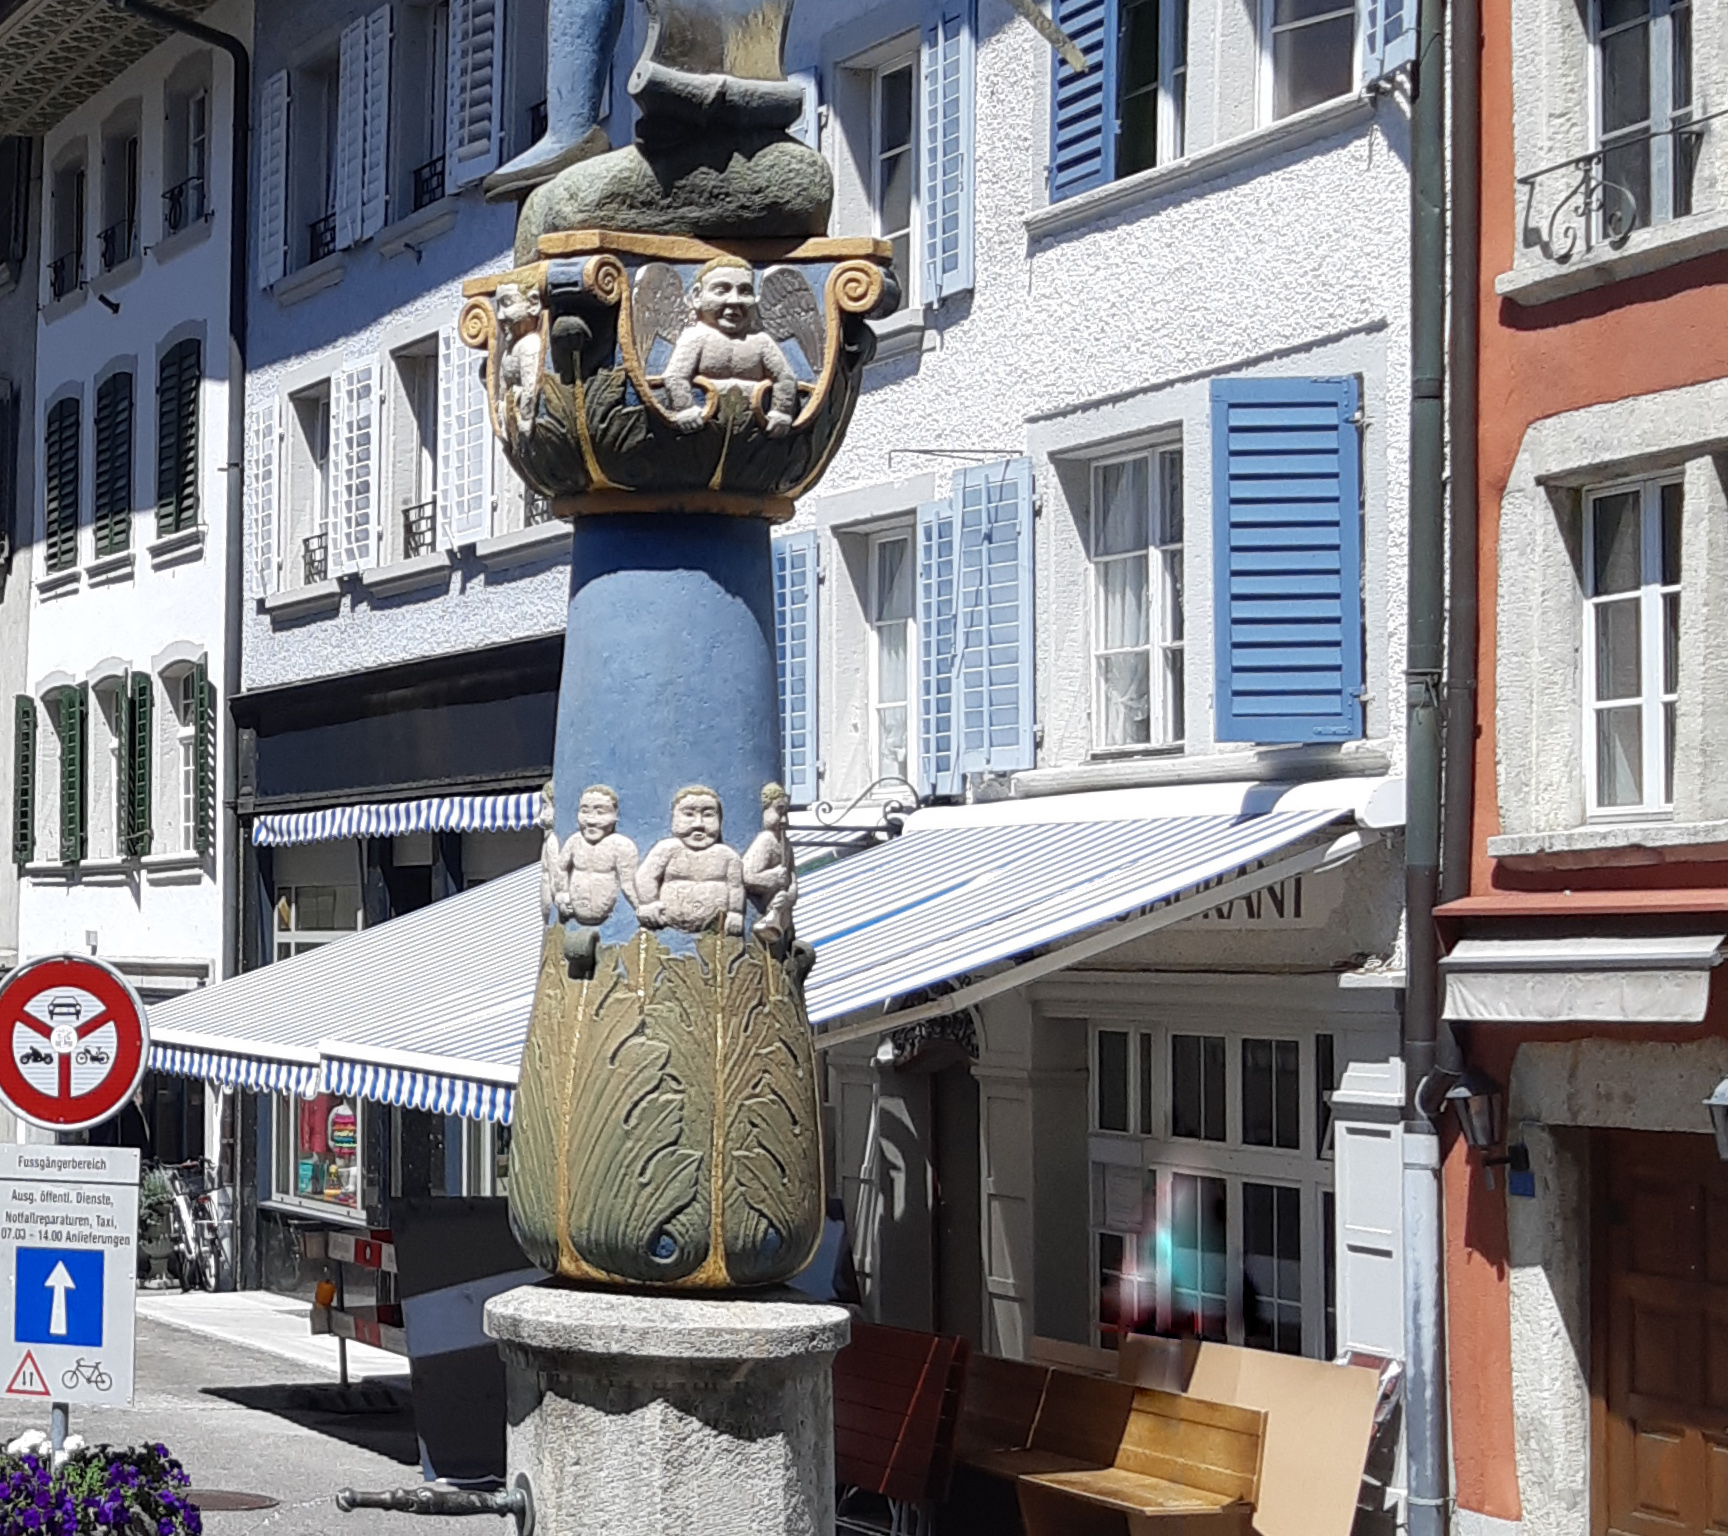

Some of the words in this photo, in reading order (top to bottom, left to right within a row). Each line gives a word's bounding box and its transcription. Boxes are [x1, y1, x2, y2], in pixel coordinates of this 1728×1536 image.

[18, 1155, 107, 1171] Fussgängerbereich
[11, 1189, 37, 1204] Ausg.
[40, 1190, 72, 1203] öffentl.
[76, 1192, 114, 1207] Dienste,
[96, 1215, 117, 1229] Taxi,
[65, 1230, 130, 1247] Anlieferungen
